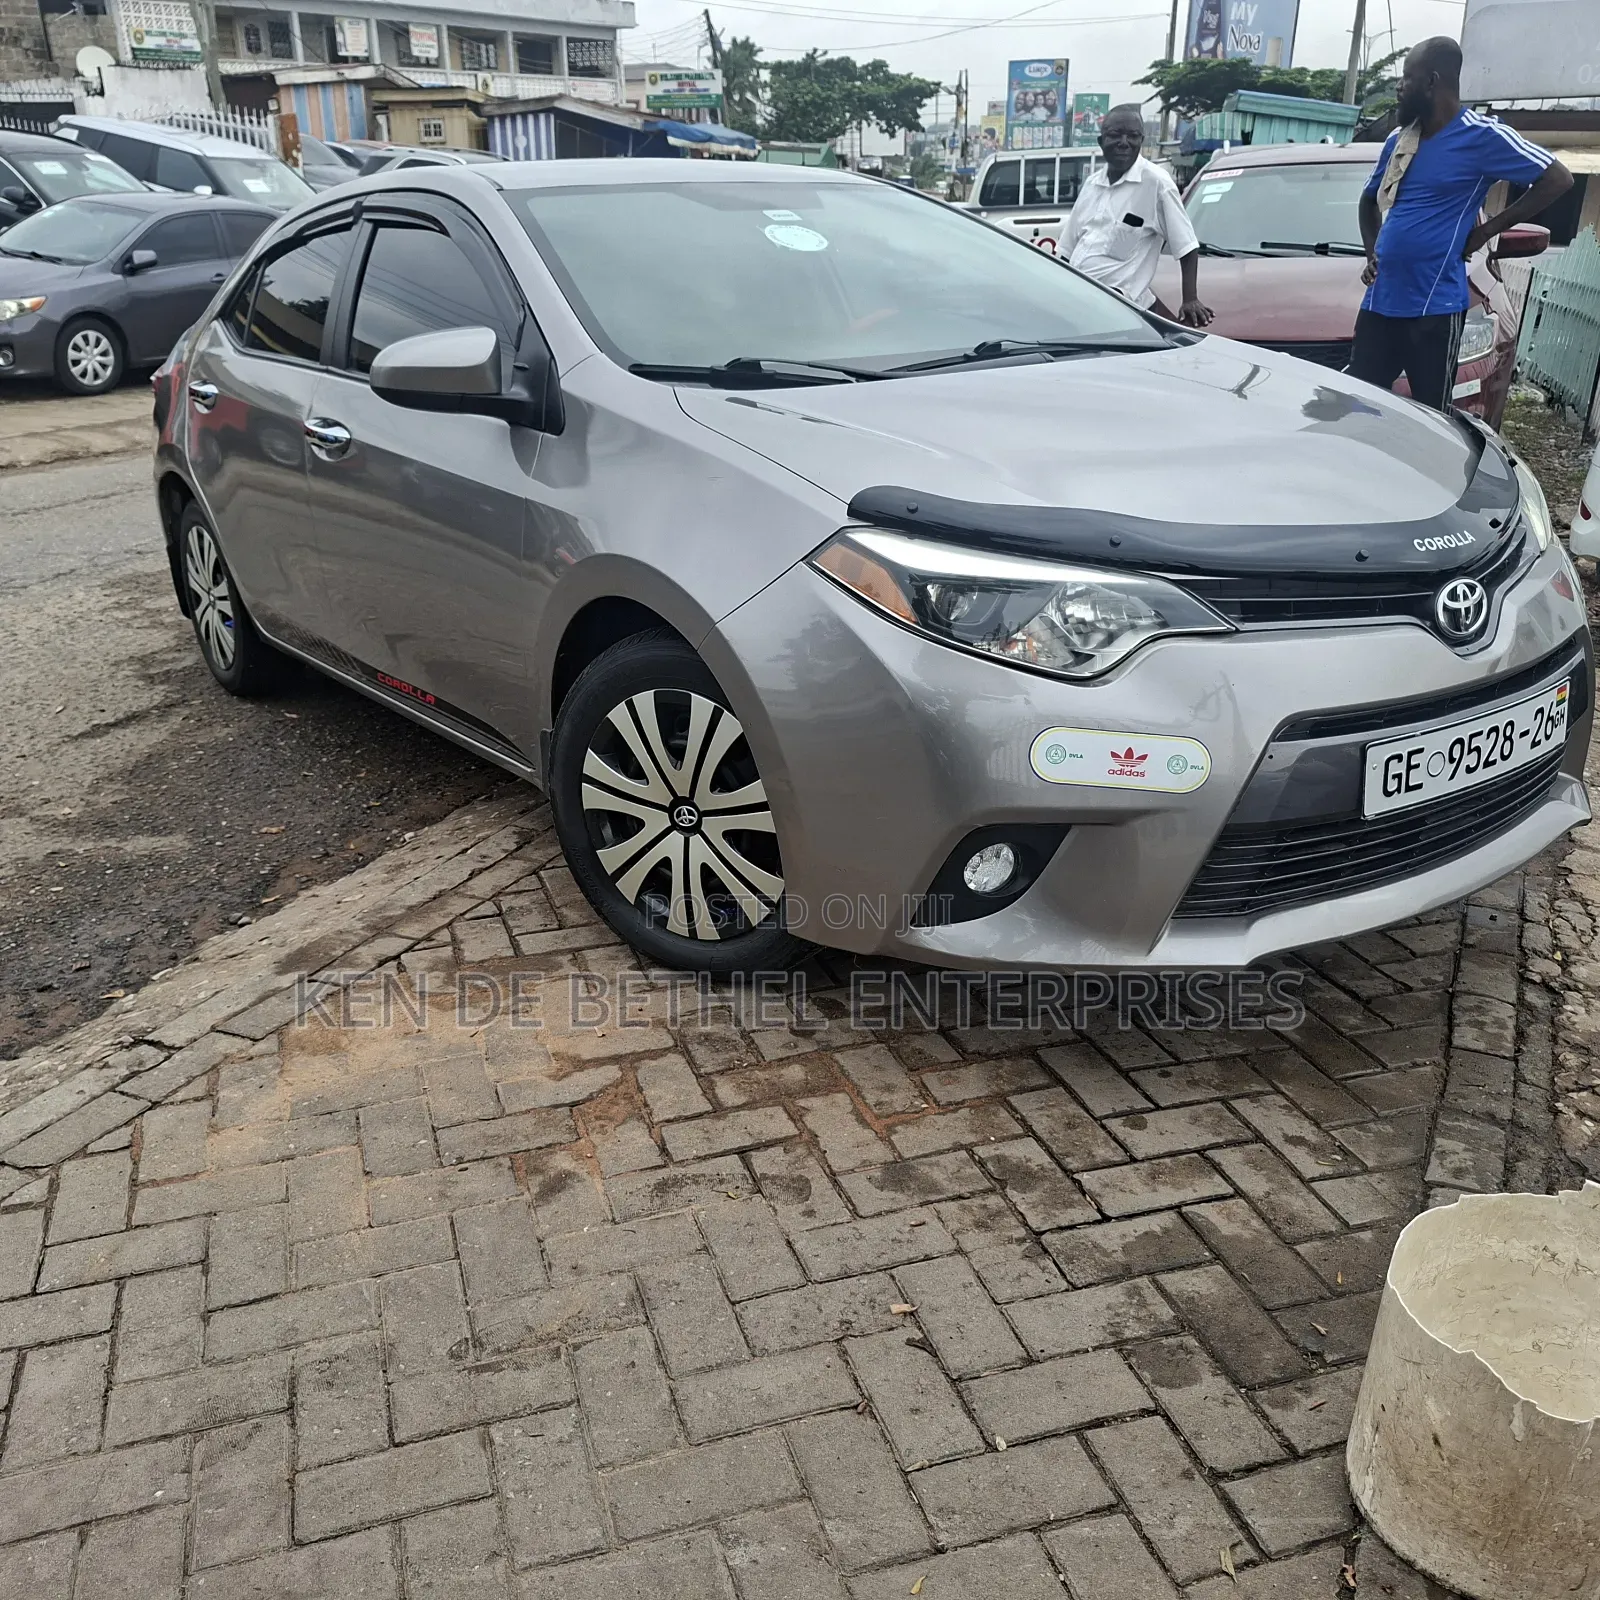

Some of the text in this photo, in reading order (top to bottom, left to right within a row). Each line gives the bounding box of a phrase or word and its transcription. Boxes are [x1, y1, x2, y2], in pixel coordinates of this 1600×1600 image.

[1227, 24, 1261, 52] Nova
[1413, 530, 1476, 552] COROLLA
[377, 672, 435, 704] COROLLA
[1553, 707, 1566, 730] GH
[1107, 768, 1146, 778] adidas
[1382, 747, 1425, 798] GE
